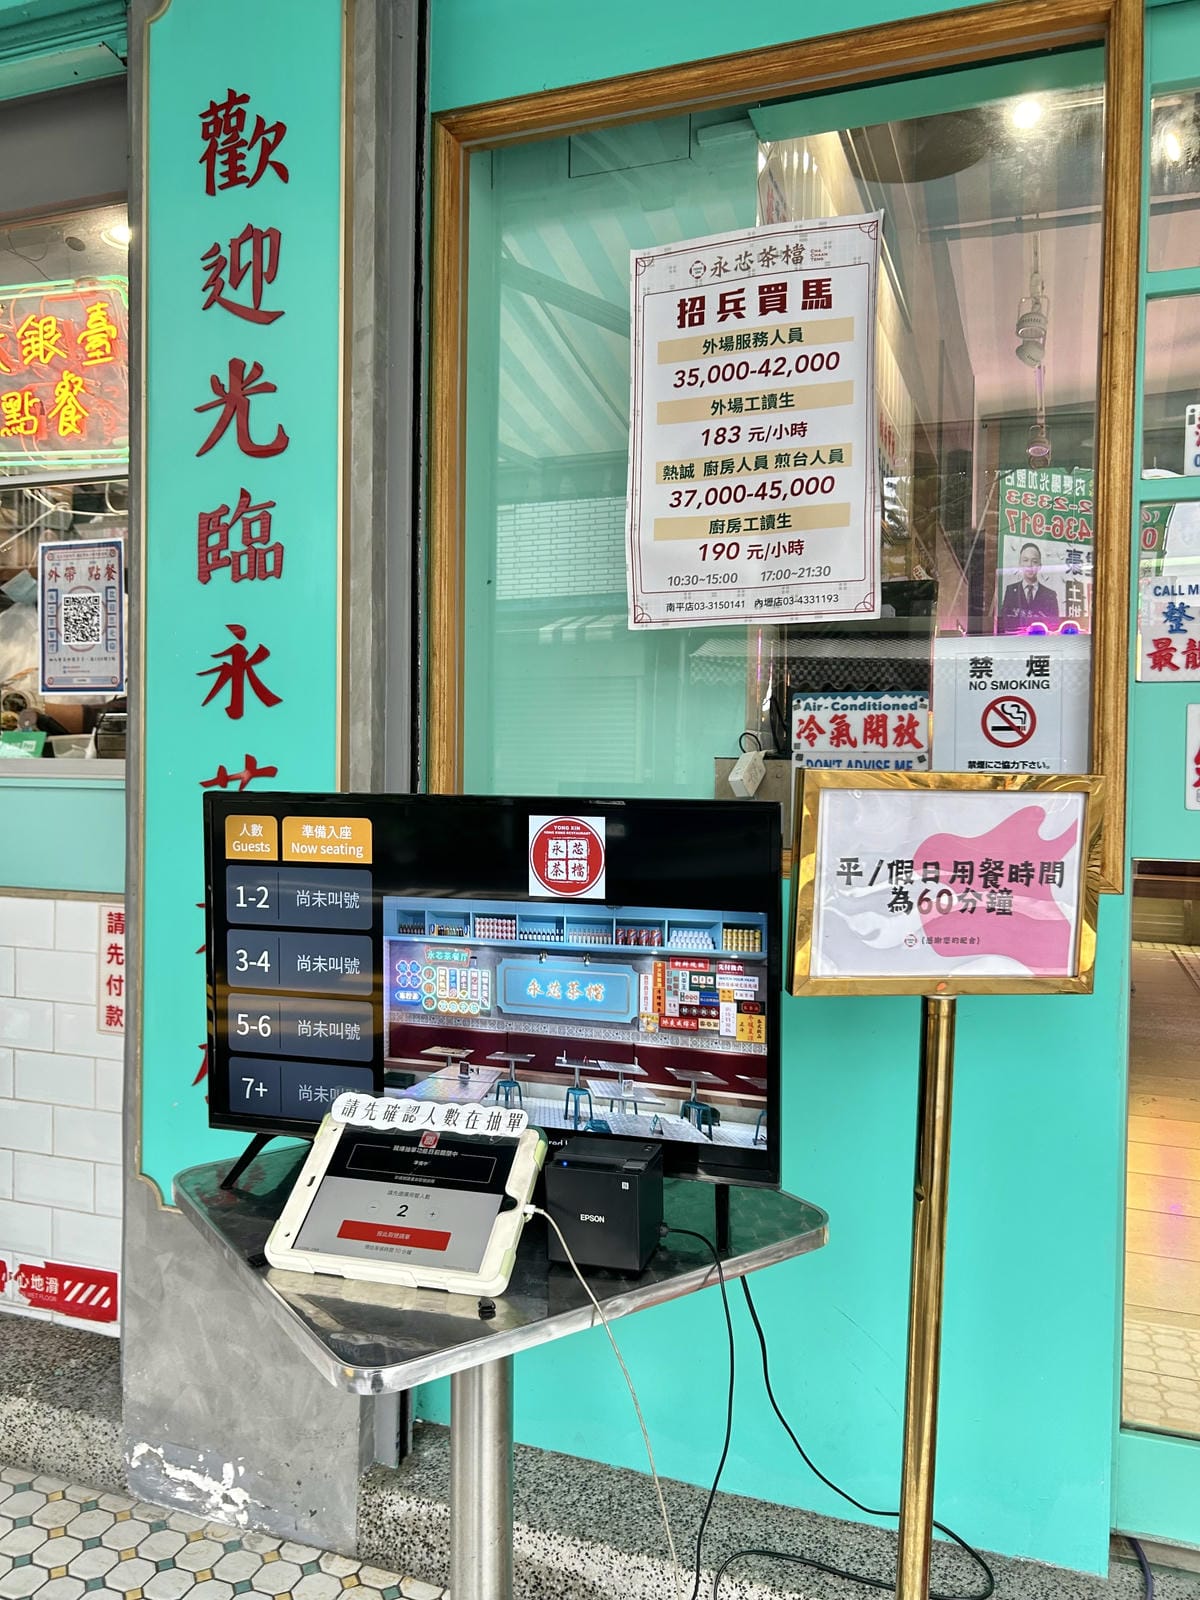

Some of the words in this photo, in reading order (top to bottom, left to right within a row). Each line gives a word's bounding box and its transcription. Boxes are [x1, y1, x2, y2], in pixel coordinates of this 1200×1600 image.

[710, 243, 806, 278] 永芯茶檔
[677, 278, 832, 329] 招兵買馬
[702, 327, 804, 355] 外場服務人員
[673, 351, 840, 388] 35,000-42,000
[0, 370, 89, 437] 點餐
[711, 392, 795, 416] 外場工讀生
[701, 425, 741, 446] 183
[748, 421, 808, 443] 元/小時
[703, 454, 769, 477] 廚房人員
[774, 448, 844, 469] 煎台人員
[669, 475, 835, 510] 37,000-45,000
[709, 513, 792, 535] 廚房工讀生
[698, 541, 740, 562] 190
[747, 539, 805, 561] 元/小時
[667, 572, 738, 587] 10:30~15:00
[760, 565, 831, 582] 17:00~21:30
[1153, 585, 1185, 596] CALL
[666, 600, 746, 612] 南平店03-3150141
[969, 681, 987, 690] NO
[991, 680, 1050, 690] SMOKING
[803, 701, 918, 712] Air-Conditioned
[796, 713, 924, 749] 冷氣開放
[239, 824, 263, 837] 人數
[301, 825, 352, 840] 準備入座
[232, 841, 271, 853] Guests
[291, 843, 317, 854] Now
[320, 843, 364, 858] seating
[836, 857, 1065, 889] 平/假日用餐時間
[236, 886, 270, 908] 1-2
[296, 890, 360, 909] 尚未叫號
[887, 886, 1013, 916] 為60分鐘
[106, 911, 125, 1028] 請先付款
[236, 949, 271, 973] 3-4
[296, 954, 360, 975] 尚未叫號
[236, 1013, 272, 1037] 5-6
[297, 1019, 361, 1040] 尚未叫號
[241, 1077, 268, 1099] 7+
[341, 1099, 523, 1132] 請先確認人數在抽單
[396, 1204, 409, 1217] 2
[580, 1213, 605, 1223] EPSON
